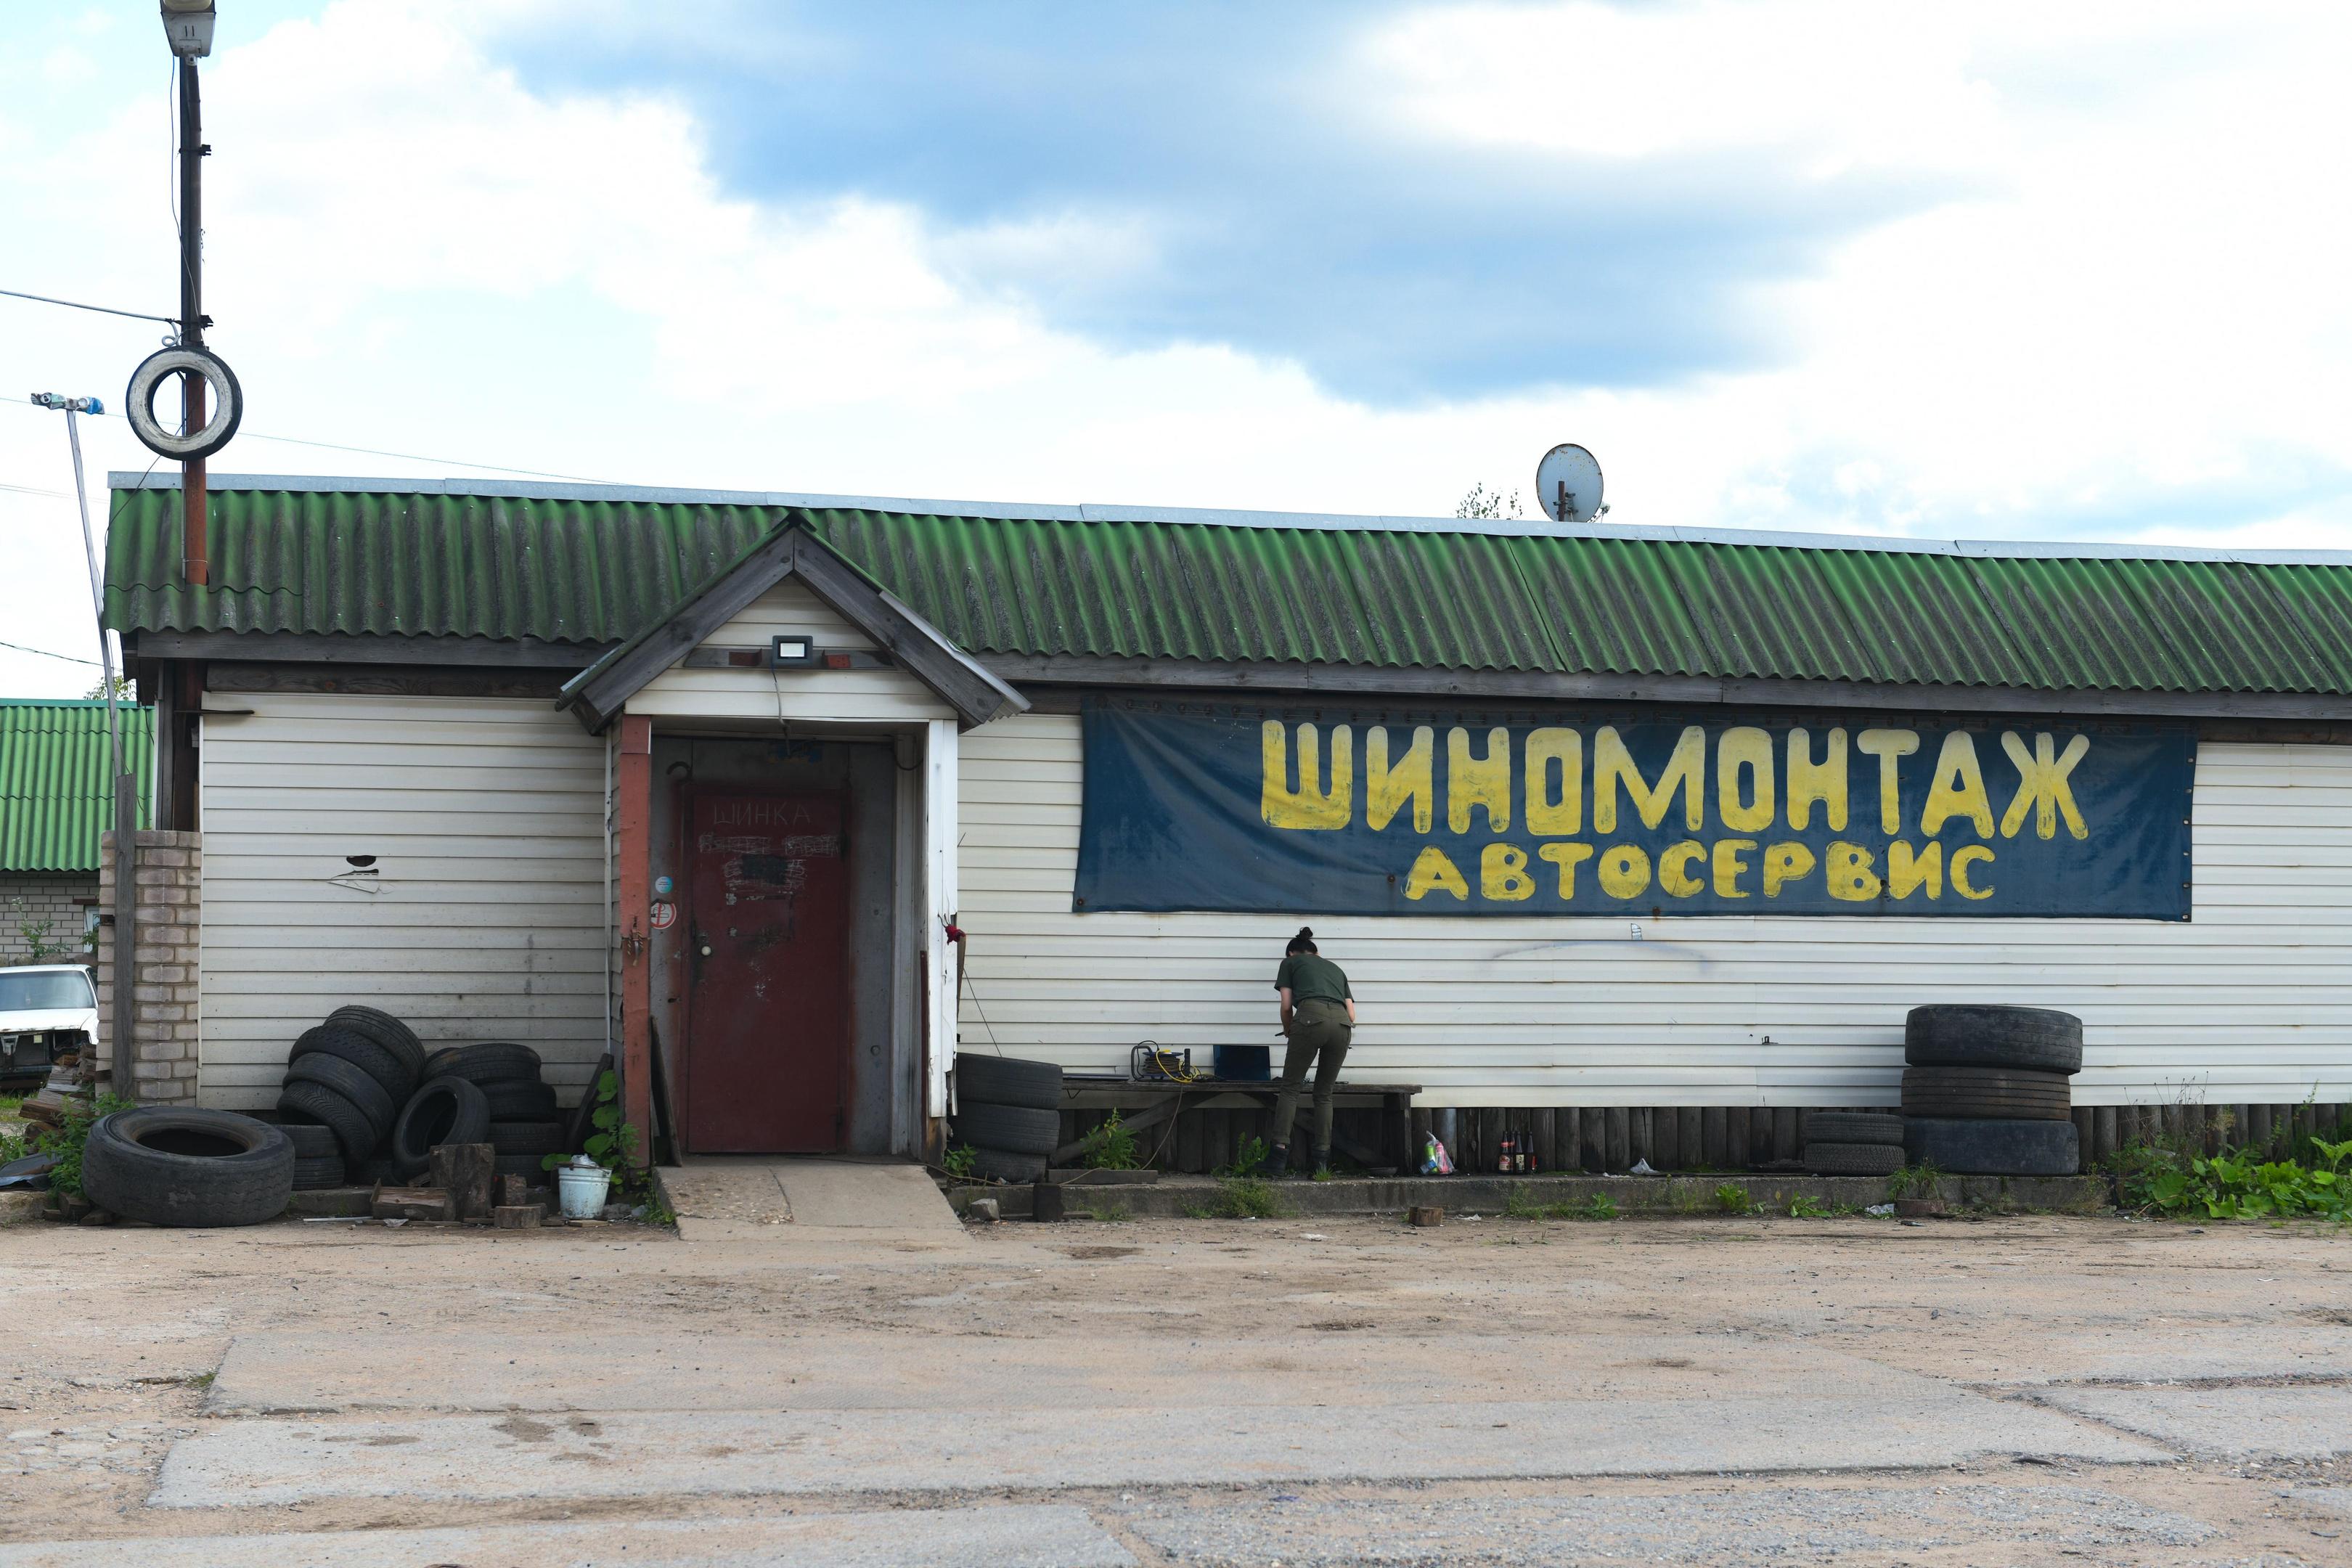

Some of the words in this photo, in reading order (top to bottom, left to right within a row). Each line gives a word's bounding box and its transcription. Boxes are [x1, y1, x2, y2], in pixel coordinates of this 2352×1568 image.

[1261, 719, 2090, 839] ШИНОМОНТАЖ
[714, 801, 811, 825] ШИНКА
[1402, 839, 1996, 902] АВТОСЕРВИС
